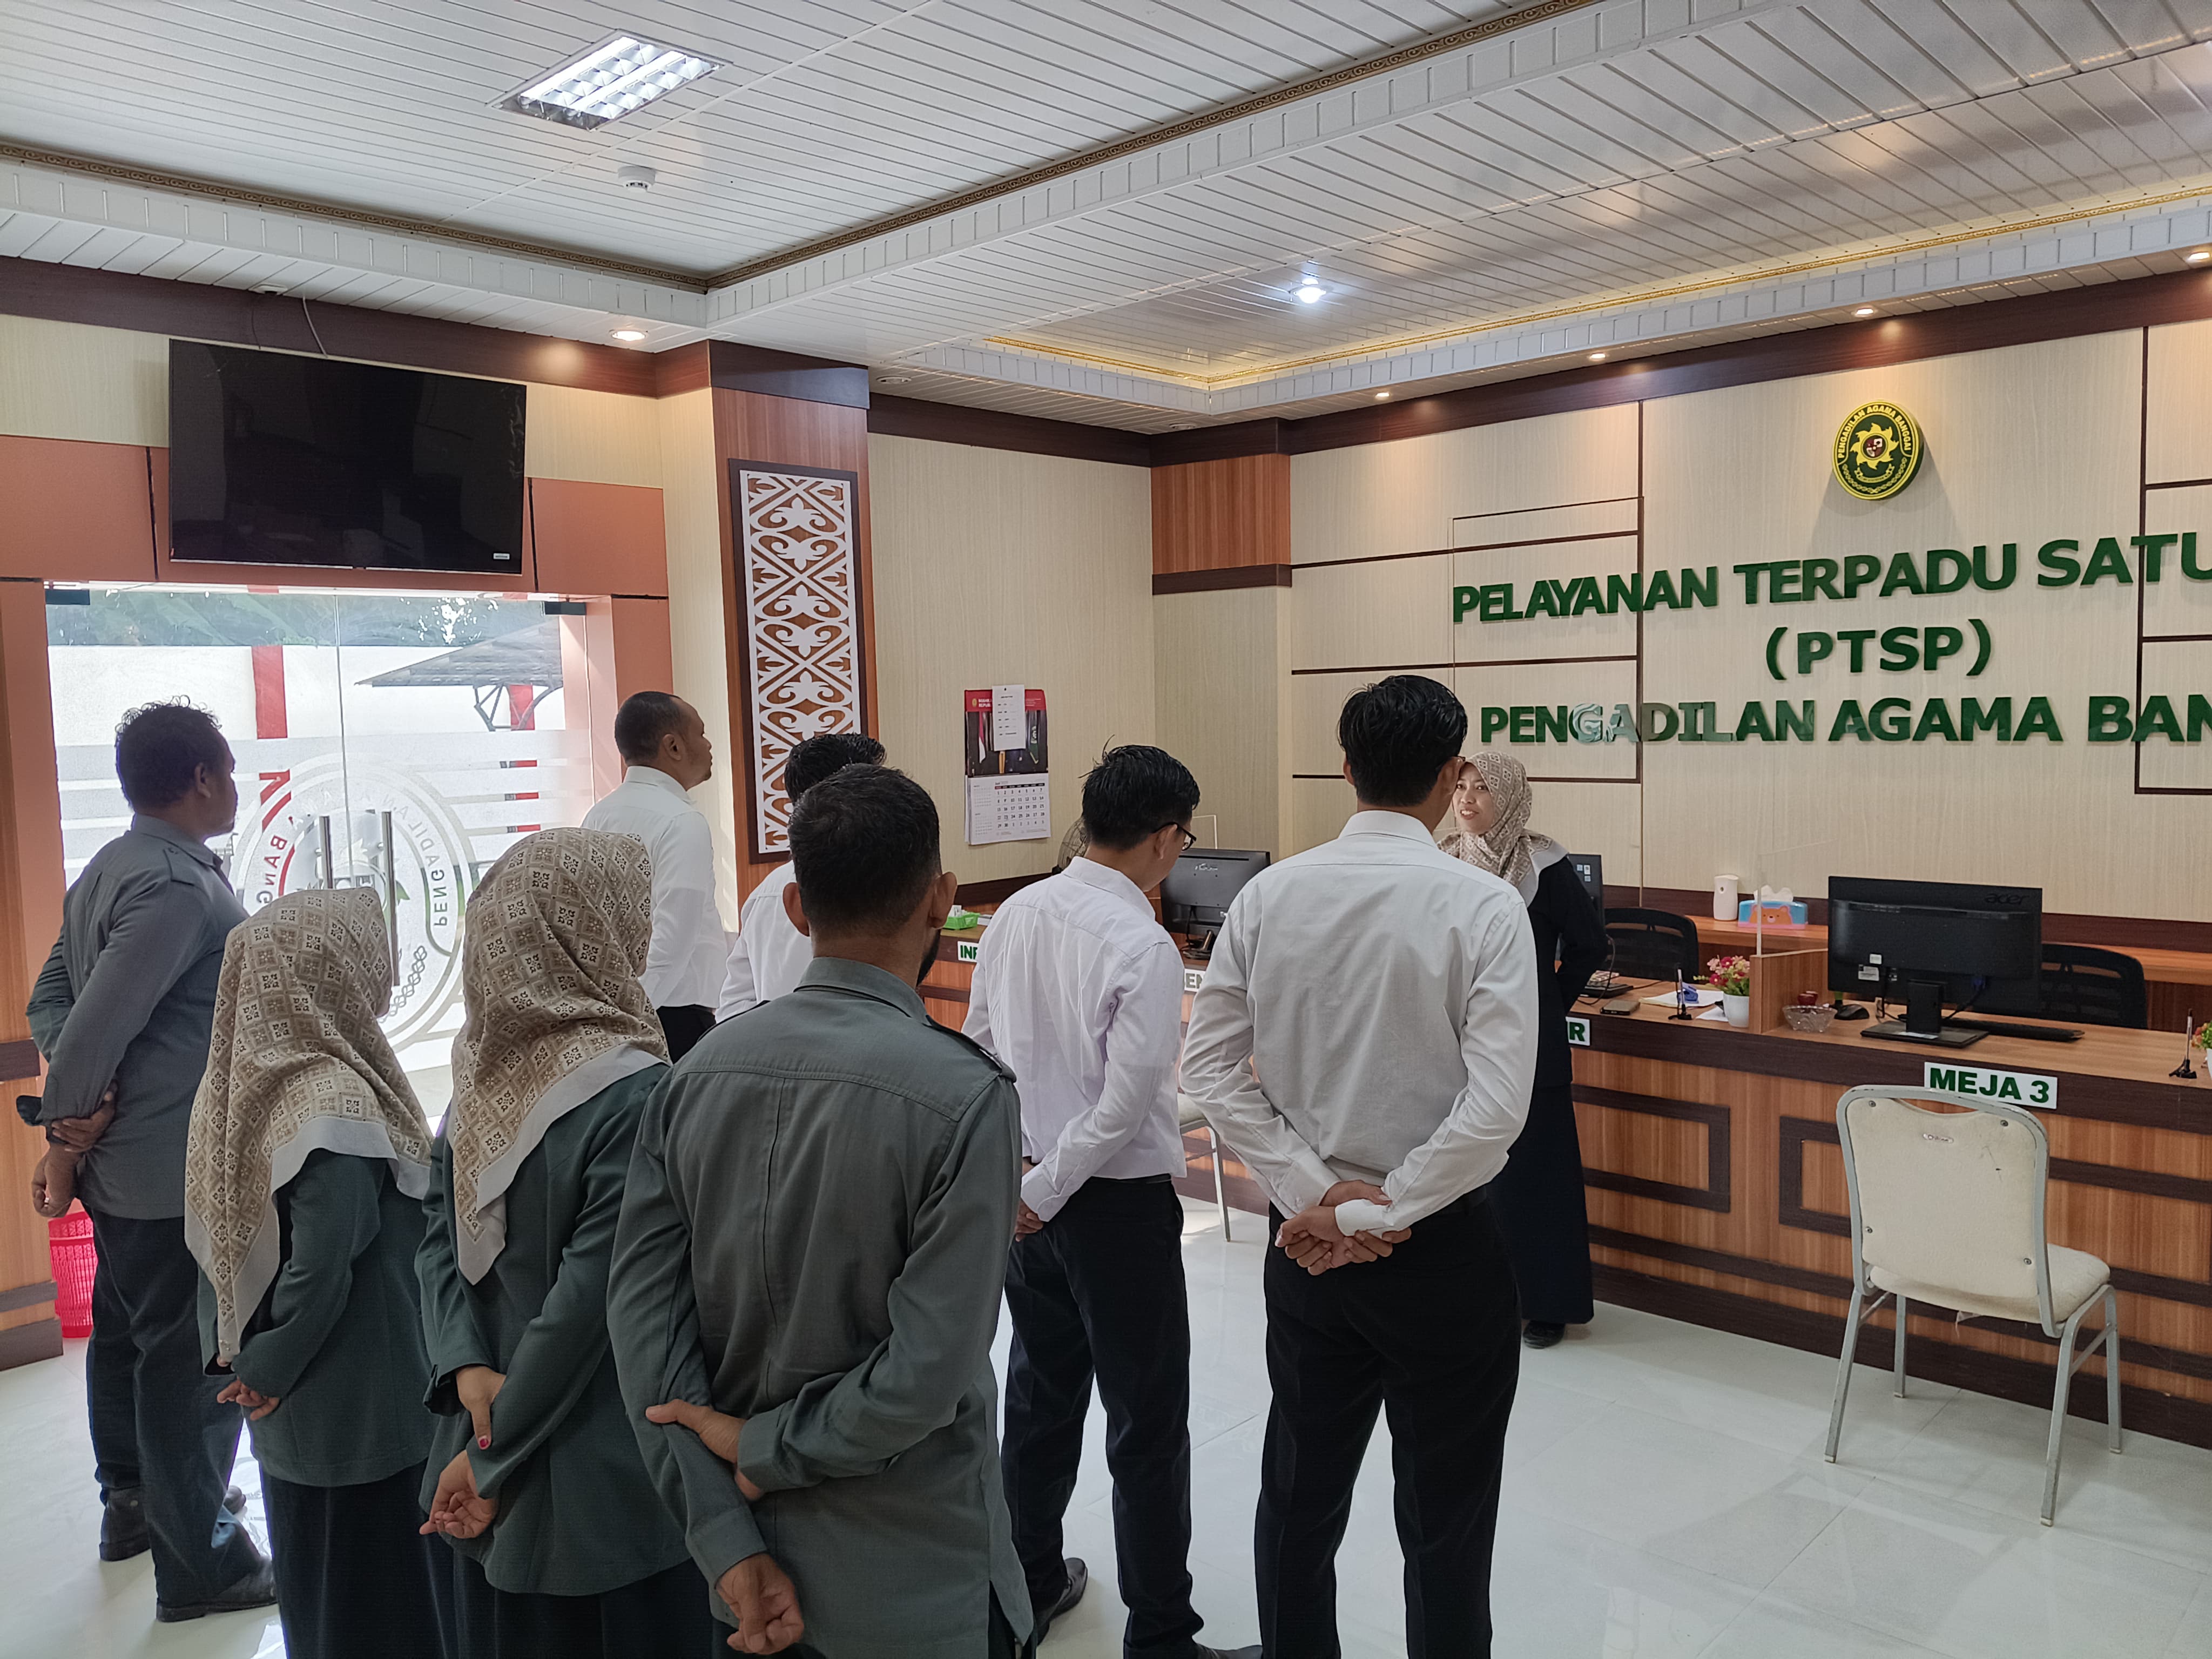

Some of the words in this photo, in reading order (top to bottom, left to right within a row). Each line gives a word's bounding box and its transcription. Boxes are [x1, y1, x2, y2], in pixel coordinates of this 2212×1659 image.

[1838, 409, 1865, 459] PENGADILAN
[1866, 404, 1896, 418] AGAMA
[1894, 413, 1912, 451] BANGGAI
[1453, 566, 1718, 623] PELAYANAN
[1734, 543, 2017, 604] TERPADU
[2038, 532, 2212, 587] SATU
[1766, 619, 1992, 680] (PTSP)
[1481, 700, 1815, 743] PENGADILAN
[1829, 696, 2063, 741] AGAMA
[1930, 1067, 2022, 1100] MEJA
[2029, 1080, 2049, 1103] 3
